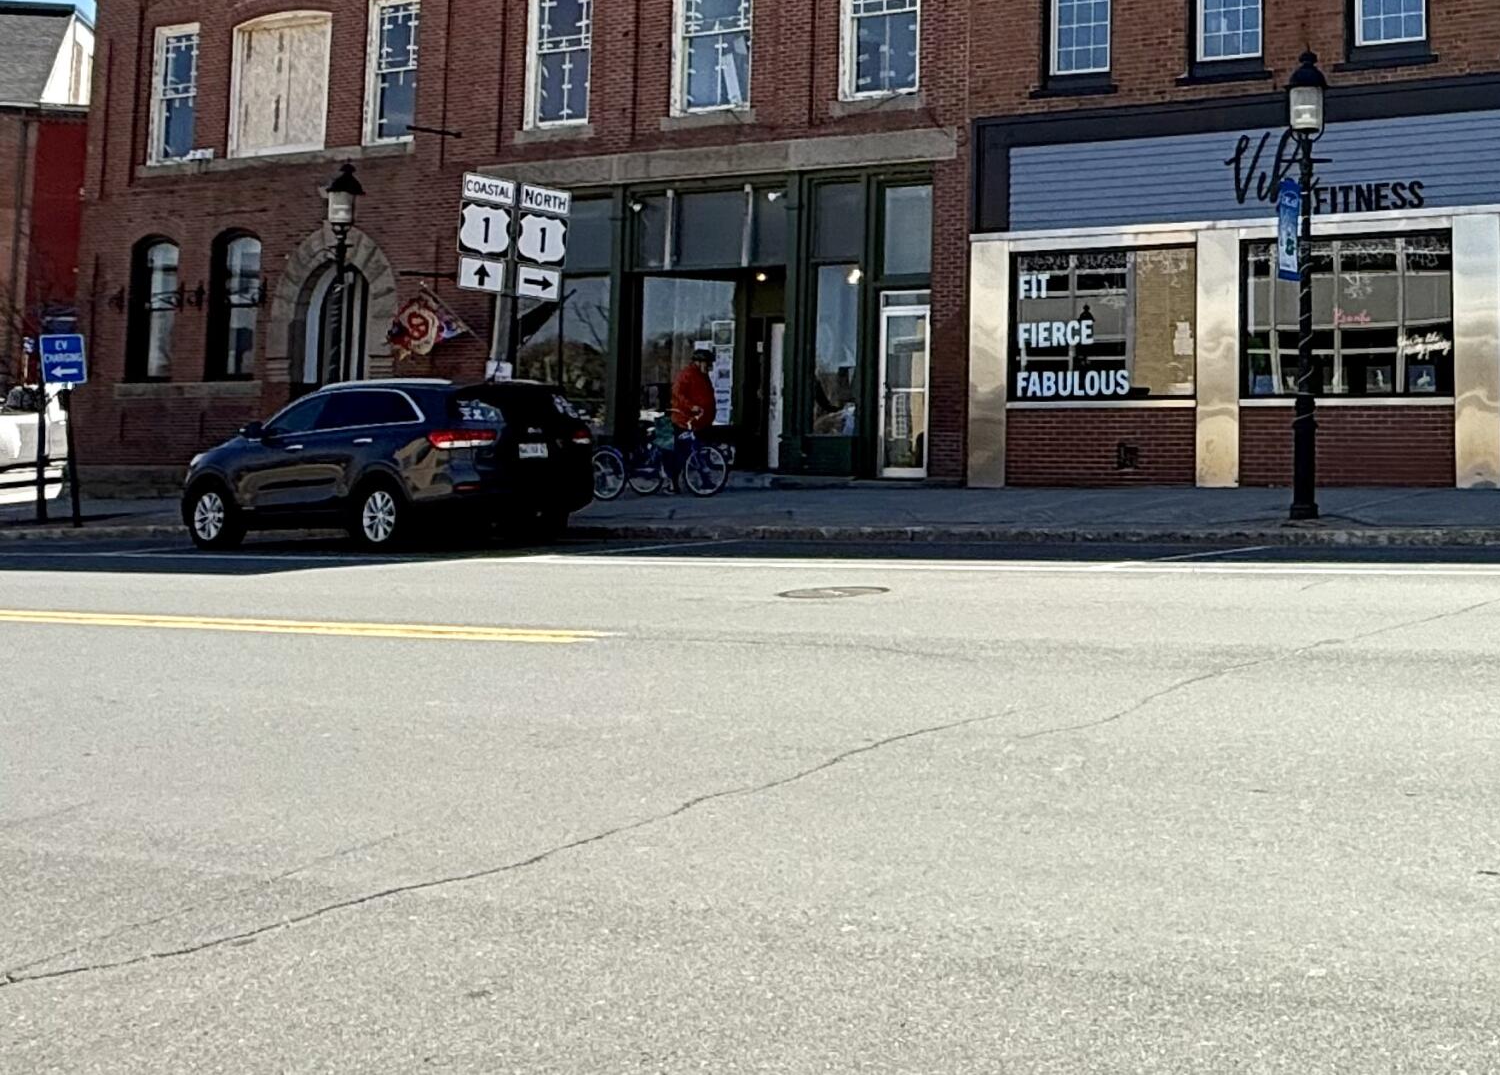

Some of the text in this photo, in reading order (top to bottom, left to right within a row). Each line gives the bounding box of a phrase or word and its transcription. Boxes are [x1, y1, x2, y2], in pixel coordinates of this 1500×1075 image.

[466, 179, 511, 200] COASTAL
[525, 189, 567, 211] NORTH
[1313, 180, 1425, 215] FITNESS
[482, 216, 491, 244] 1
[539, 227, 547, 254] 1
[1019, 273, 1050, 300] FIT
[1017, 320, 1094, 349] FIERCE
[1016, 370, 1130, 398] FABULOUS
